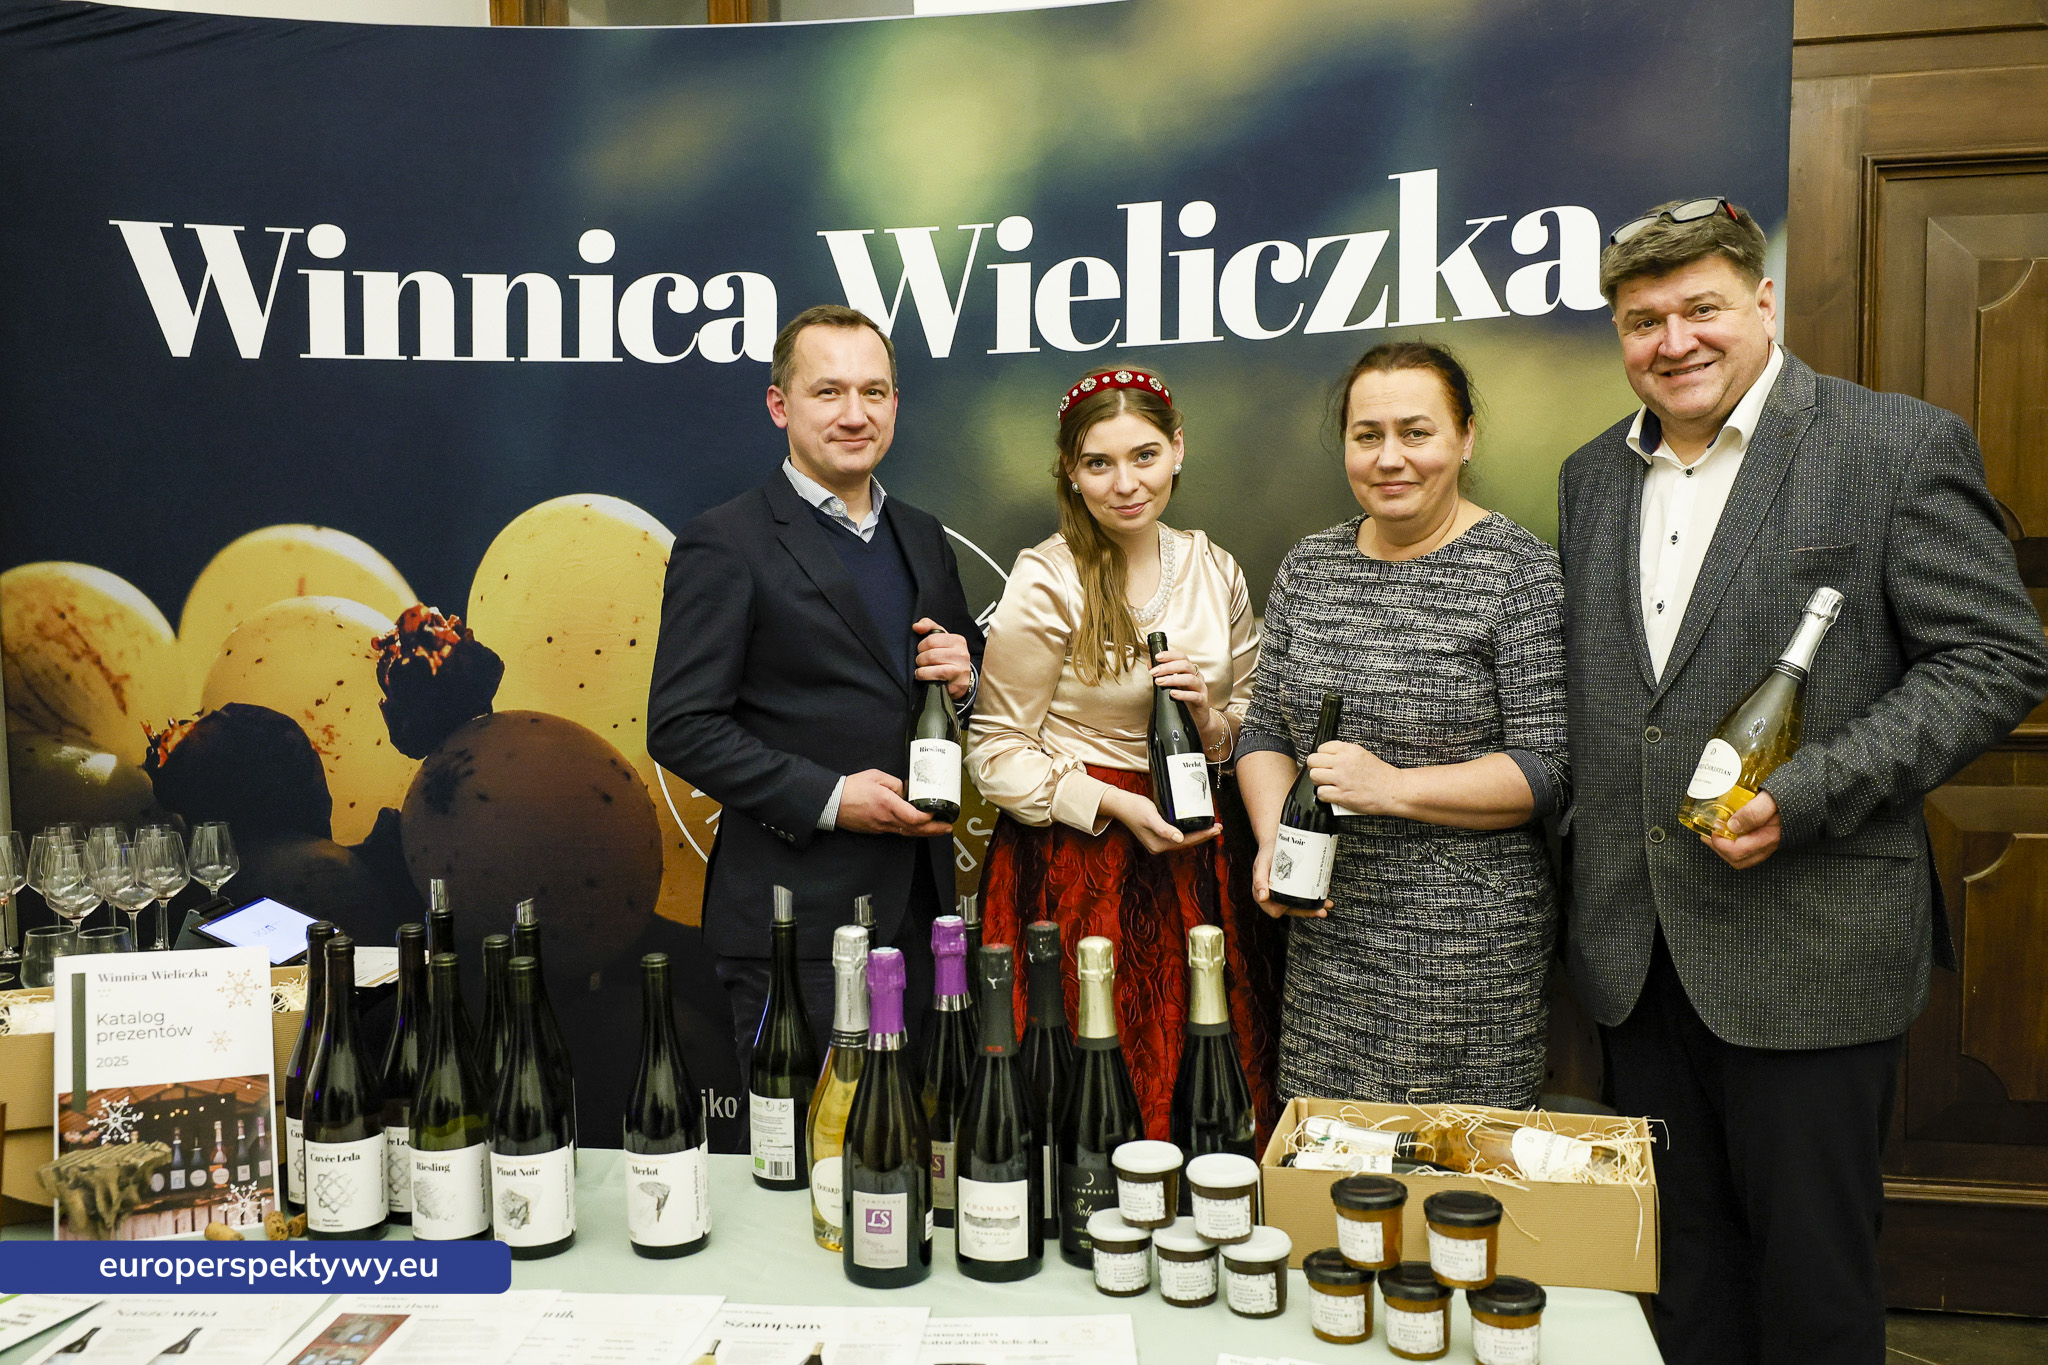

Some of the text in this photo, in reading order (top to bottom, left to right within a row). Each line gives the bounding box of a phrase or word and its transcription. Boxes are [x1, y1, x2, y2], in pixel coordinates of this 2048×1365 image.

[109, 168, 1608, 365] Winnica Wieliczka
[98, 968, 209, 984] Winnica Wieliczka
[96, 1011, 166, 1026] Katalog
[96, 1025, 194, 1045] prezentów
[96, 1056, 129, 1068] 2025
[310, 1153, 361, 1163] Cuvée Leda
[416, 1162, 451, 1173] Riesling
[496, 1166, 541, 1177] Pinot Noir
[631, 1165, 659, 1176] Merlot
